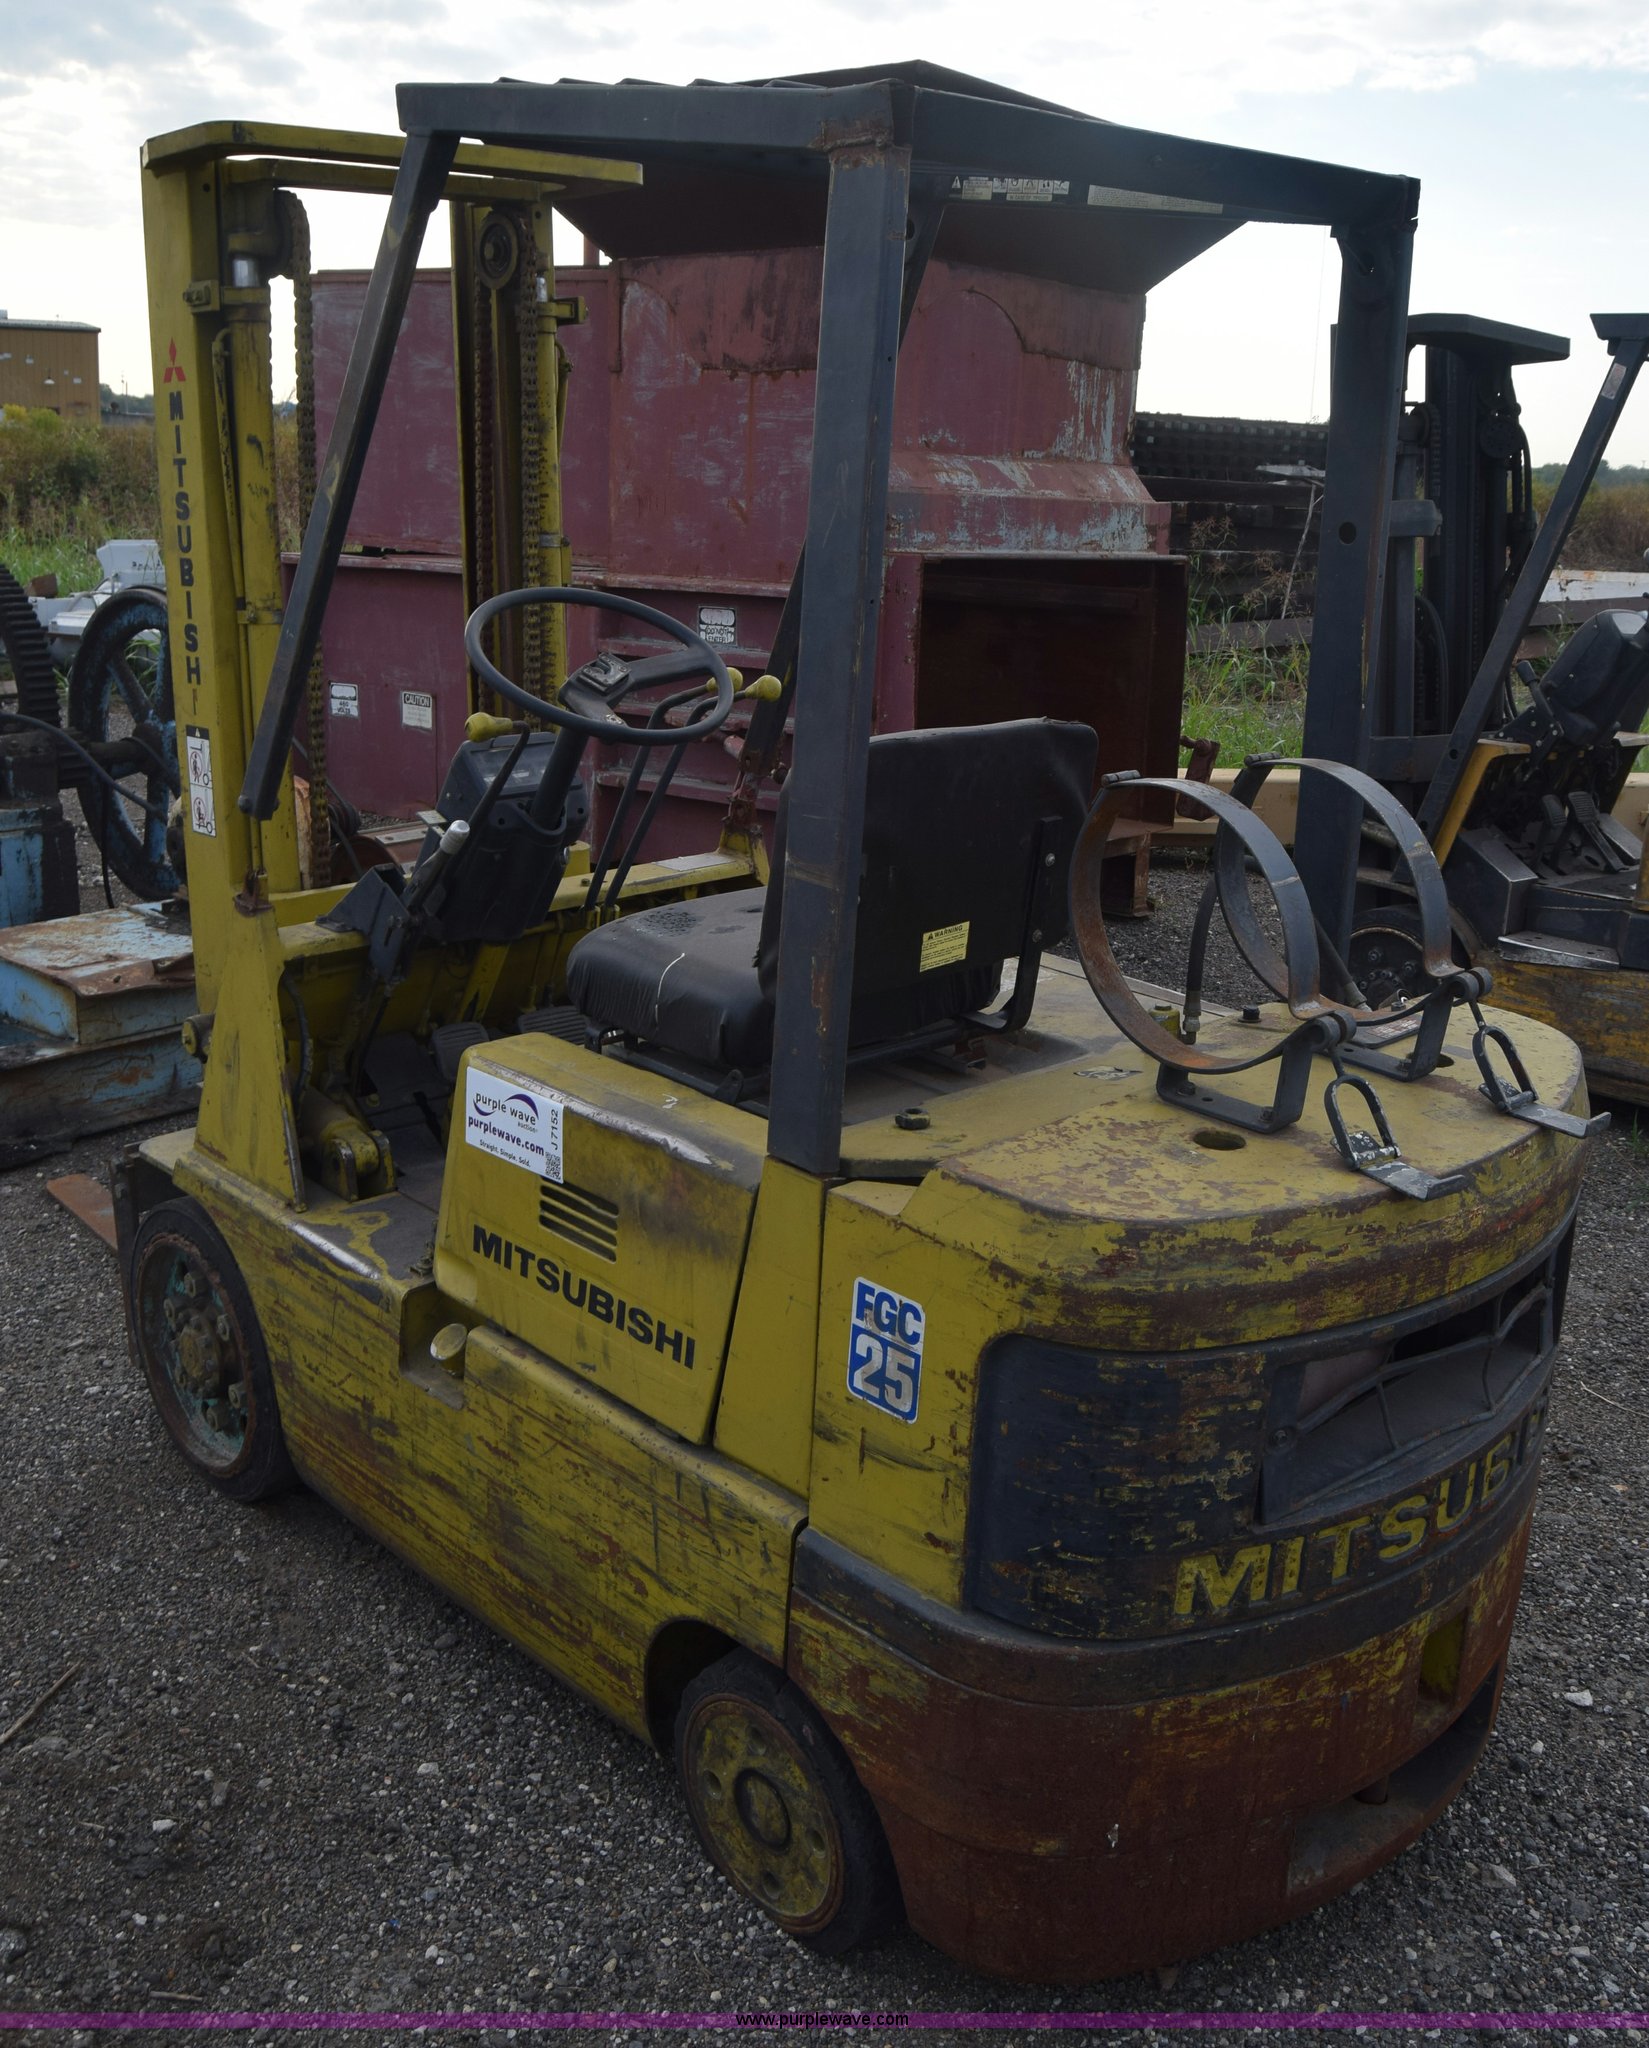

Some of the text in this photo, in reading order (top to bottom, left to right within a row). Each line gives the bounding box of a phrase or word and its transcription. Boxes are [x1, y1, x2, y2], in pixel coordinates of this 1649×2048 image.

[169, 391, 201, 716] MITSUBISHI
[404, 693, 430, 707] CAUTION
[934, 924, 963, 938] WARNING
[468, 1115, 545, 1157] purplewave.com
[475, 1093, 536, 1126] purple wave
[472, 1223, 696, 1370] MITSUBISHI
[855, 1281, 923, 1346] FGC
[852, 1333, 916, 1413] 25
